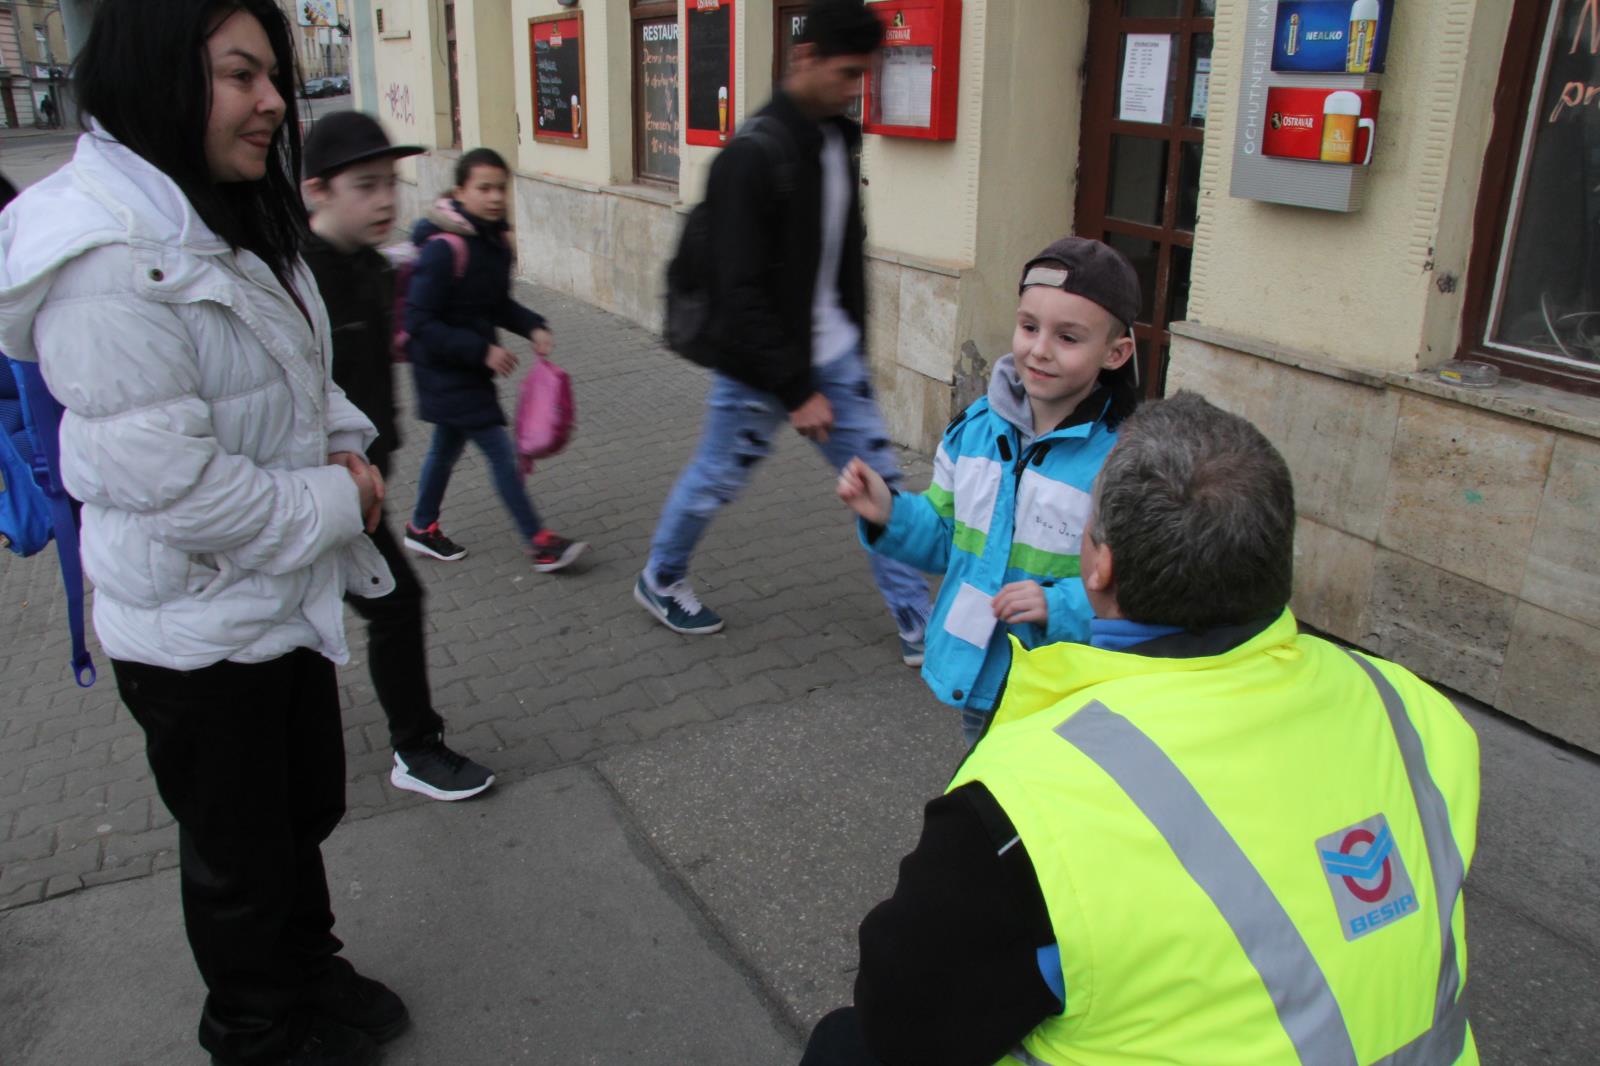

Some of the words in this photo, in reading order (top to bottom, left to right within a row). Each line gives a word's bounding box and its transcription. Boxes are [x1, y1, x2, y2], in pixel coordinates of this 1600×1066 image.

[643, 24, 679, 41] RESTAUR
[886, 28, 911, 41] OSTRAVAR
[1305, 31, 1343, 41] NEALKO
[1244, 39, 1267, 154] OCHUTNEJTE
[1257, 0, 1270, 28] NA
[1549, 81, 1600, 123] pr
[1283, 116, 1313, 128] OSTRAVAR
[1350, 894, 1413, 934] BESIP
